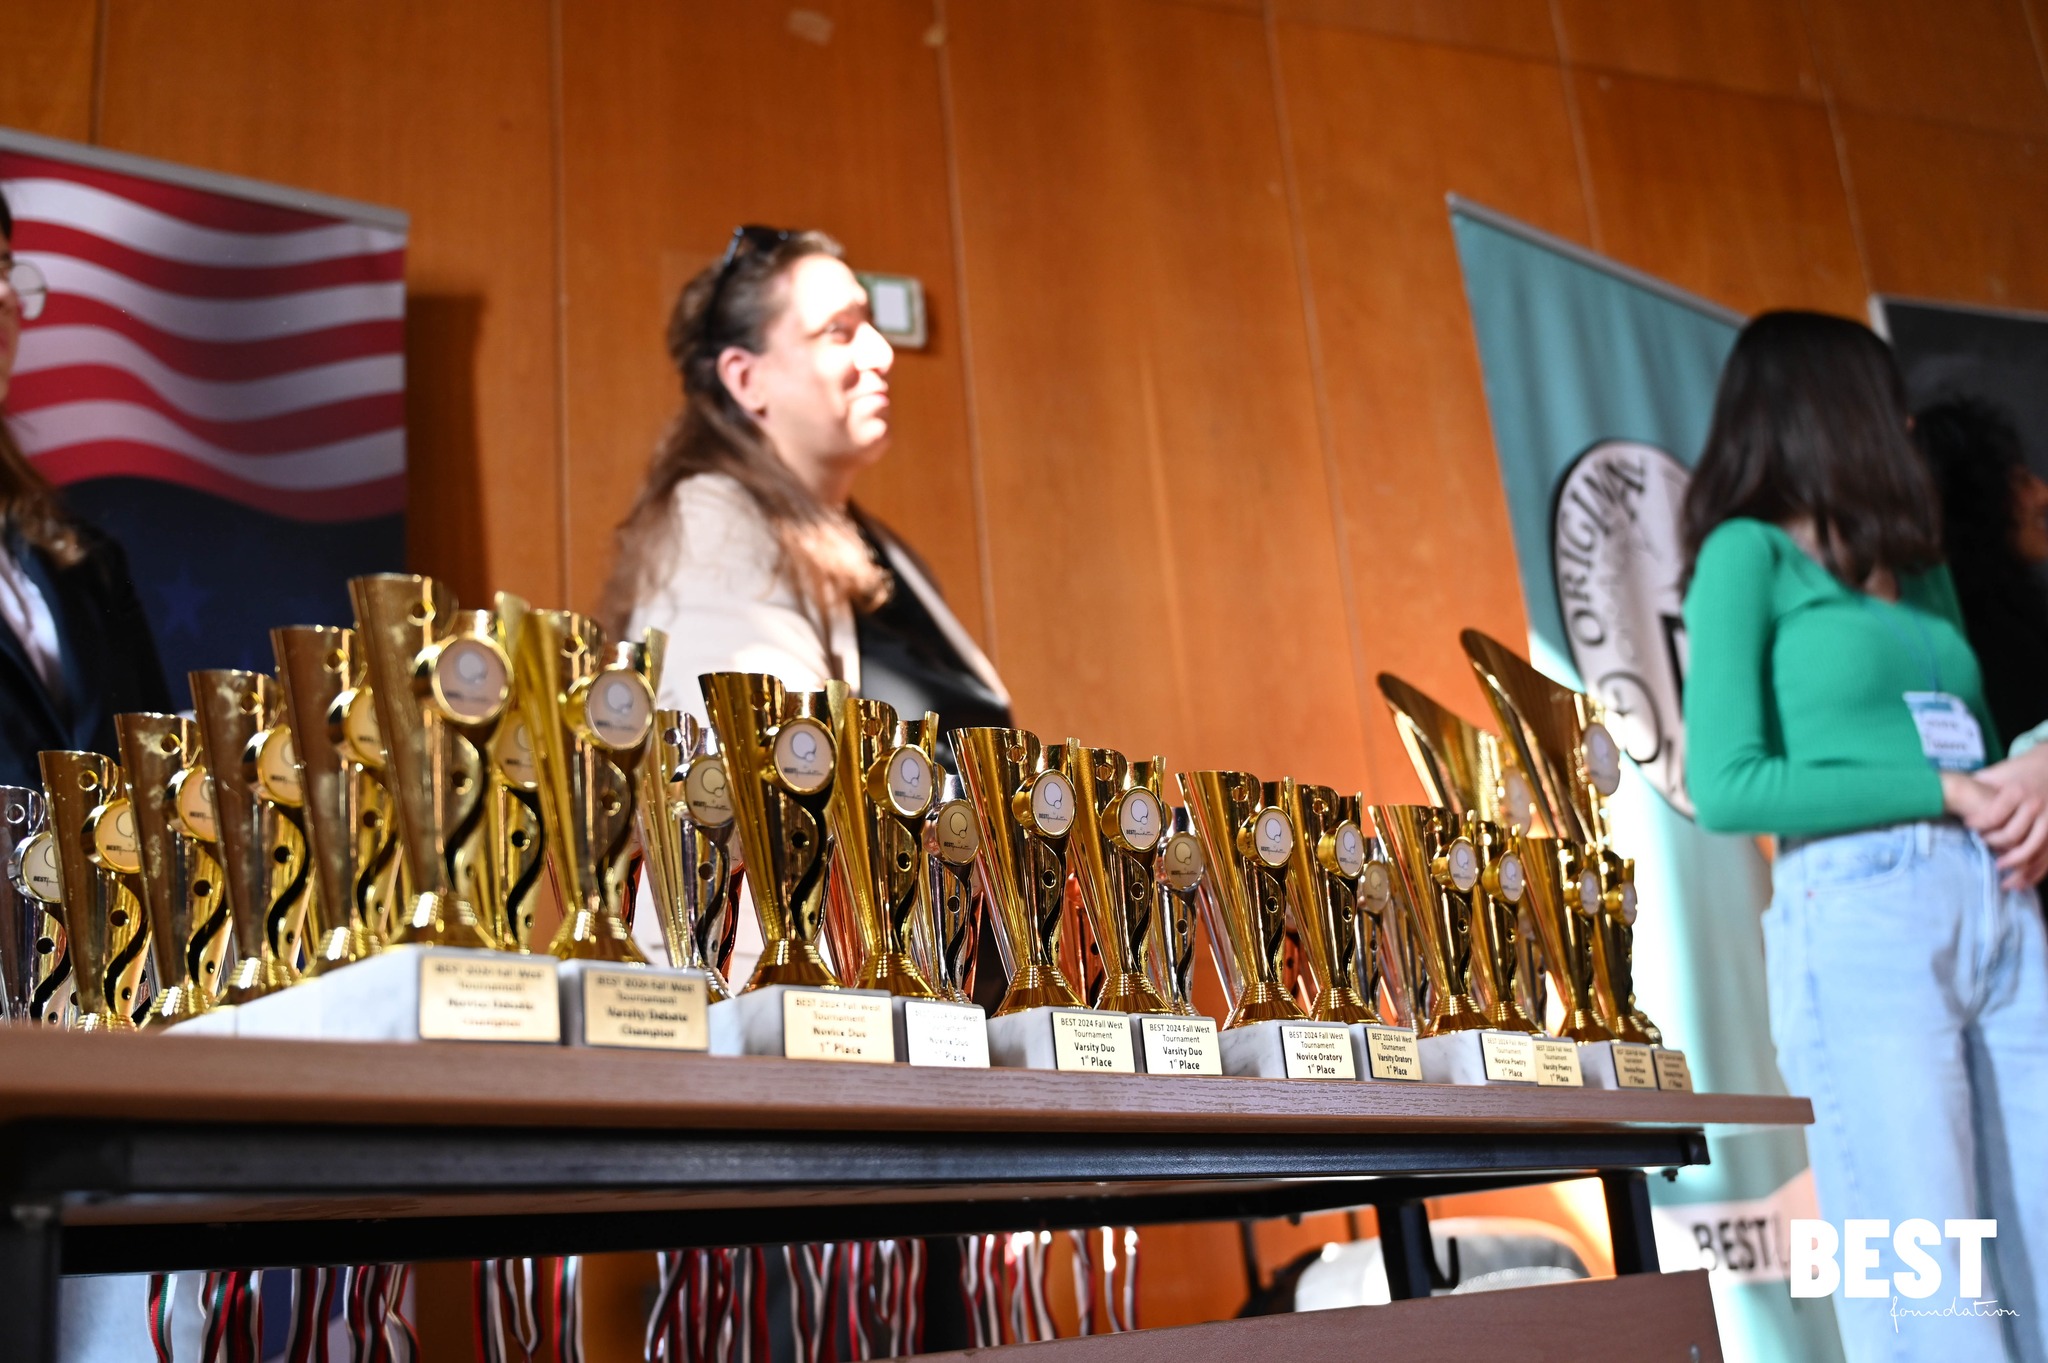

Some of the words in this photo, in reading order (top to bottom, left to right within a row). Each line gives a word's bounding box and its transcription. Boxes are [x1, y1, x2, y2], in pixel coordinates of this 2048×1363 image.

[1060, 1017, 1076, 1026] BEST
[1078, 1019, 1093, 1027] 2024
[1095, 1020, 1106, 1028] Fall
[1106, 1021, 1123, 1029] West
[1149, 1023, 1164, 1031] BEST
[1166, 1024, 1181, 1032] 2024
[1182, 1025, 1193, 1033] Fall
[1074, 1029, 1113, 1039] Tournament
[1162, 1034, 1200, 1043] Tournament
[1288, 1031, 1302, 1039] BEST
[1304, 1031, 1318, 1039] 2024
[1371, 1032, 1382, 1040] BEST
[1382, 1033, 1393, 1041] 2024
[1401, 1035, 1412, 1043] West
[1074, 1042, 1099, 1053] Varsity
[1101, 1043, 1115, 1053] Duo
[1301, 1041, 1335, 1049] Tournament
[1380, 1042, 1406, 1051] Tournament
[1162, 1046, 1187, 1057] Varsity
[1188, 1047, 1203, 1056] Duo
[1091, 1056, 1113, 1067] Place
[1296, 1052, 1318, 1061] Novice
[1318, 1052, 1343, 1063] Oratory
[1377, 1053, 1394, 1063] Varsity
[1394, 1054, 1412, 1065] Oratory
[1494, 1057, 1511, 1065] Novice
[1511, 1058, 1527, 1067] Poetry
[1179, 1060, 1200, 1070] Place
[1316, 1064, 1336, 1074] Place
[1542, 1063, 1558, 1071] Varsity
[1393, 1065, 1408, 1076] Place
[1508, 1068, 1523, 1078] Place
[1556, 1073, 1569, 1083] Place
[1692, 1216, 1770, 1272] BEST
